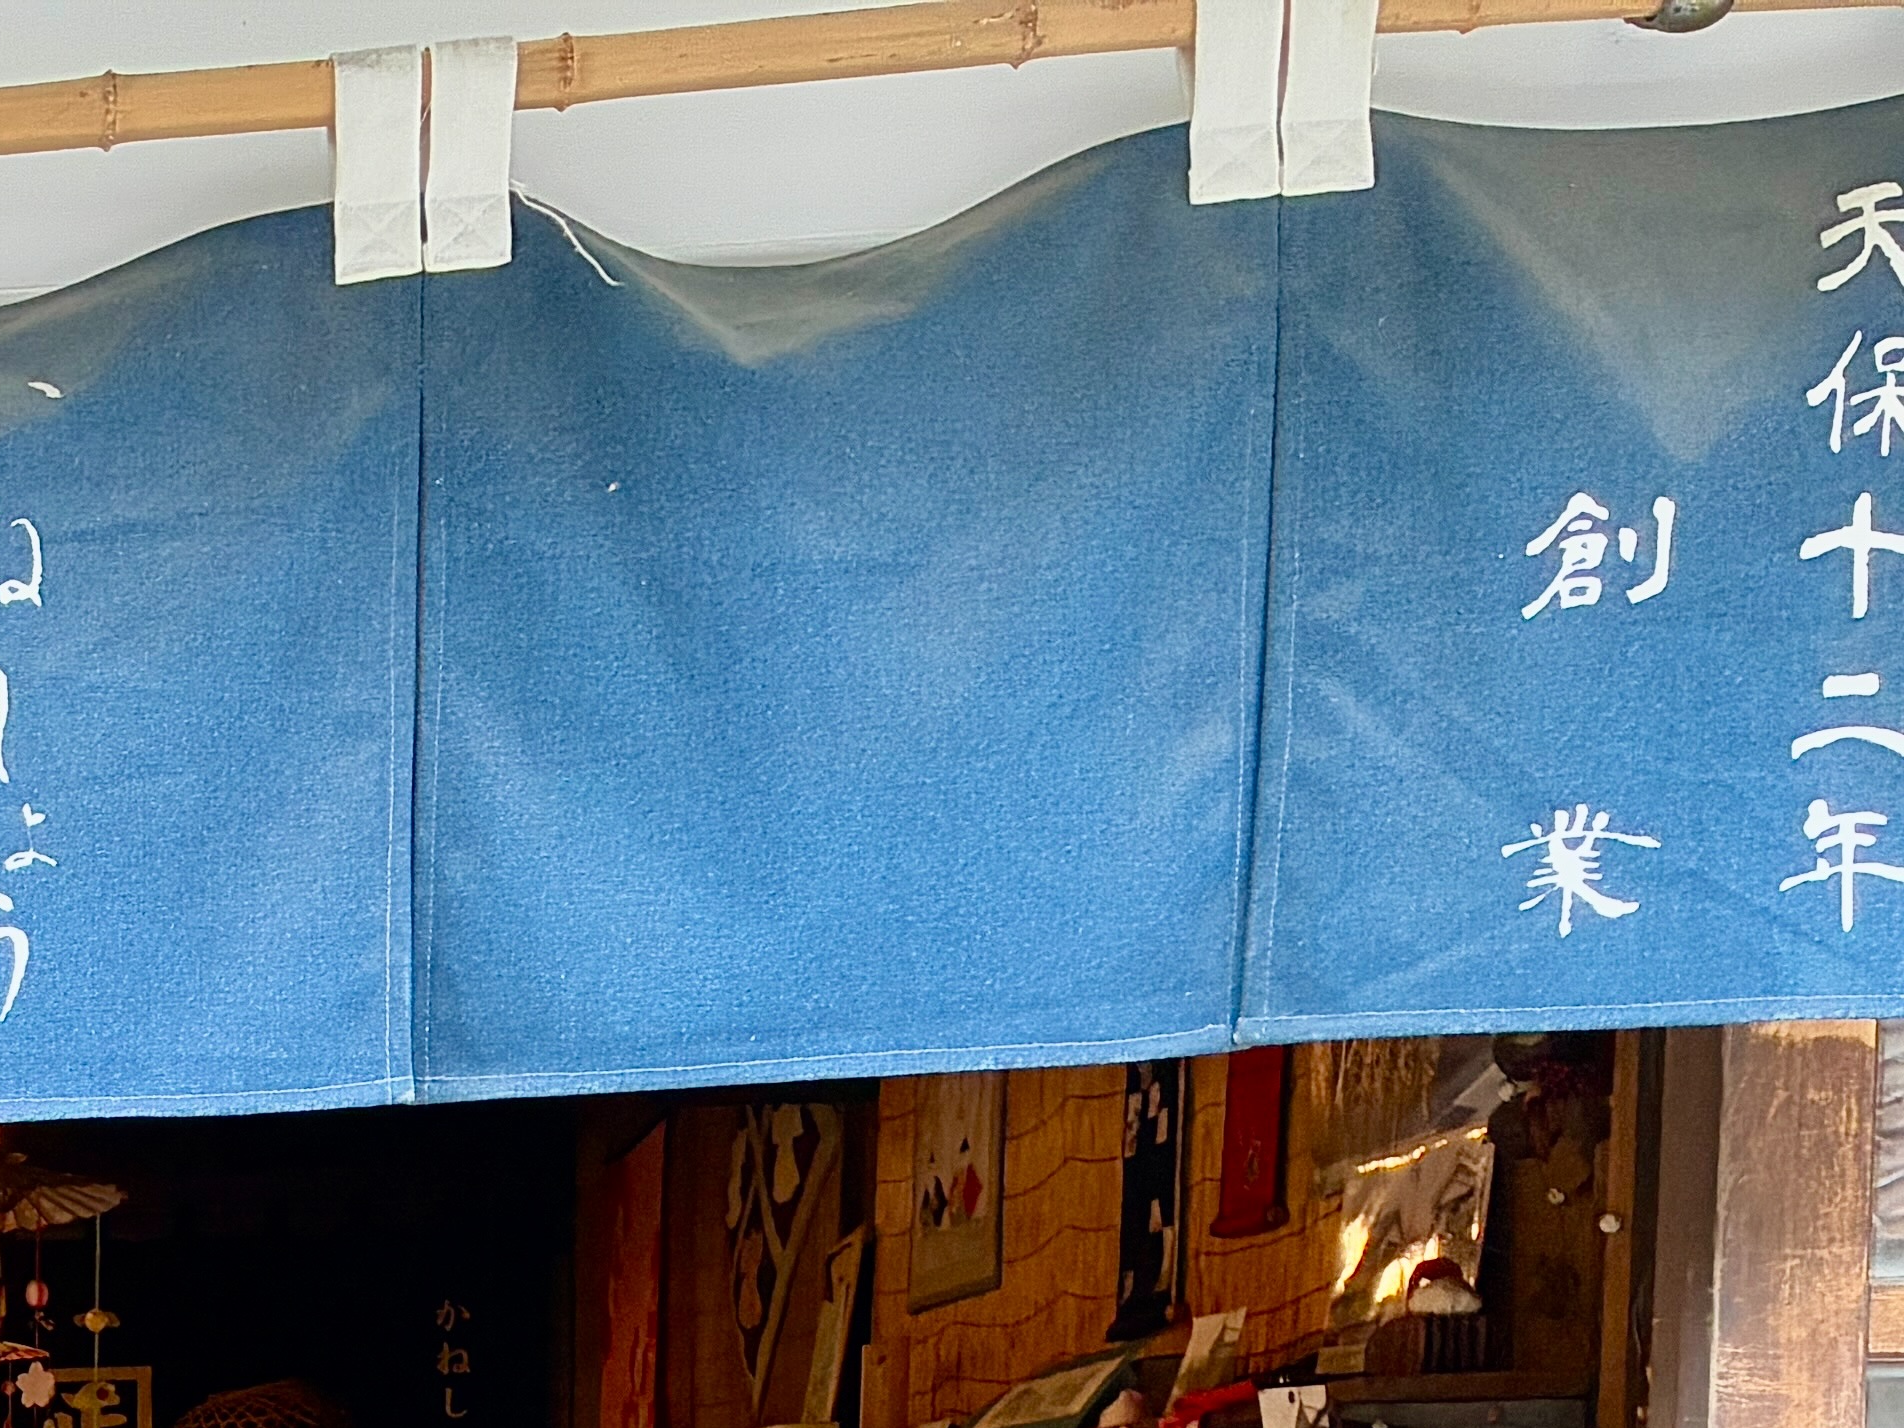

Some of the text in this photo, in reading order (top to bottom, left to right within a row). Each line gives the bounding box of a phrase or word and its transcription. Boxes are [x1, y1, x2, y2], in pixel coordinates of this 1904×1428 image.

[1502, 492, 1676, 938] 創業
[1780, 181, 1904, 933] 天保十二年
